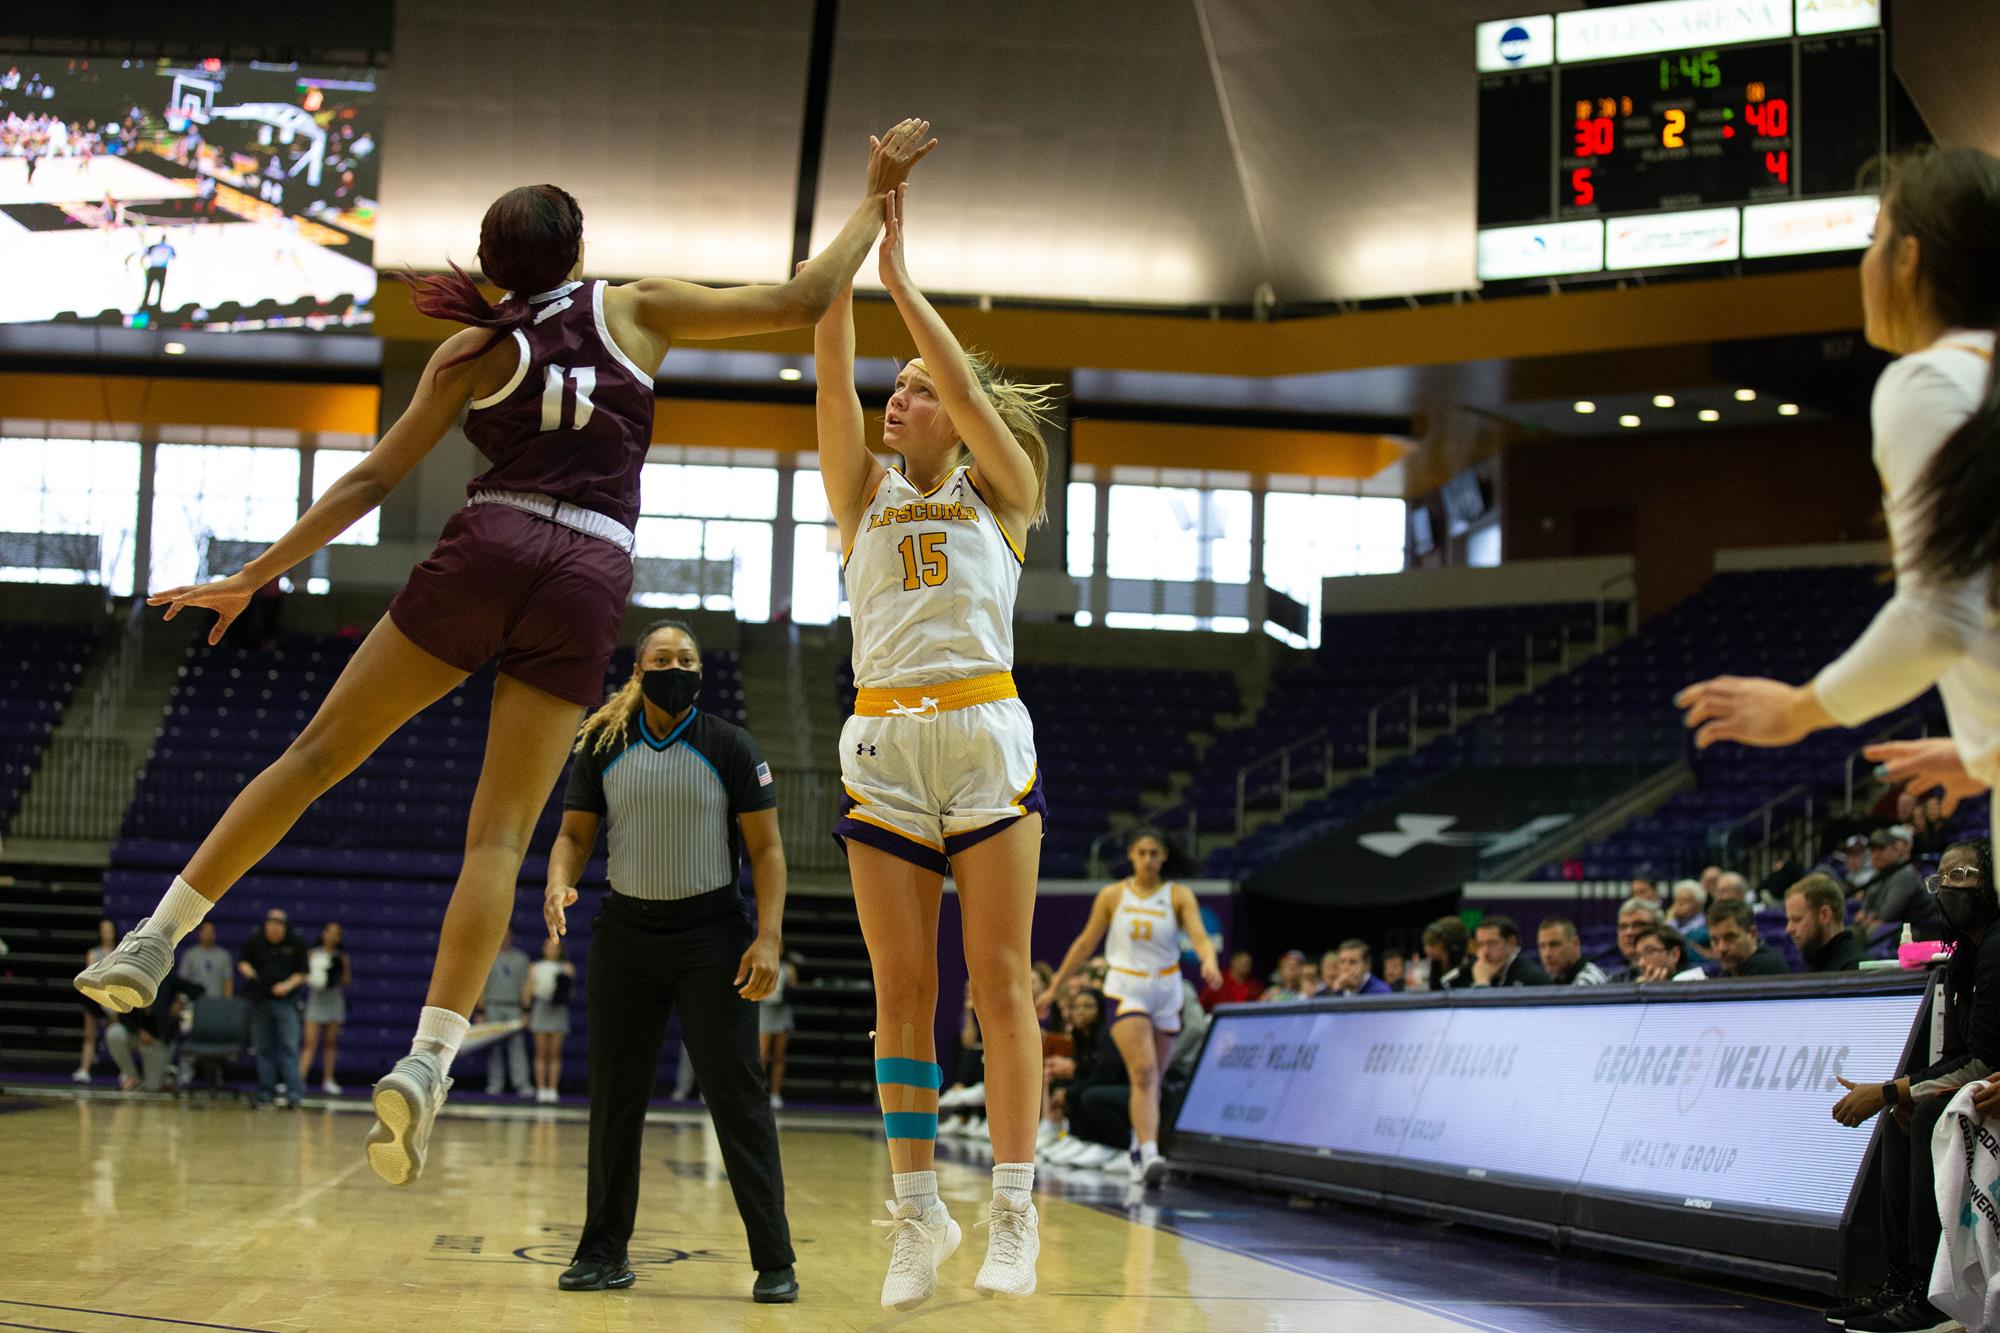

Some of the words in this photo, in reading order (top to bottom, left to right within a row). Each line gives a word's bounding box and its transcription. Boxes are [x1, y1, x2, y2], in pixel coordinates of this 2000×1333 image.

[1659, 51, 1721, 91] 1:45
[1574, 117, 1614, 157] 30
[1662, 108, 1686, 149] 2
[1744, 98, 1788, 137] 40
[1572, 166, 1594, 206] 5
[1765, 150, 1788, 184] 4
[539, 363, 597, 432] 11
[898, 531, 949, 592] 15
[1594, 1045, 1689, 1087] GEORGE
[1714, 1045, 1850, 1093] WELLONS
[1619, 1138, 1680, 1168] WEALTH
[1681, 1144, 1738, 1174] GROUP
